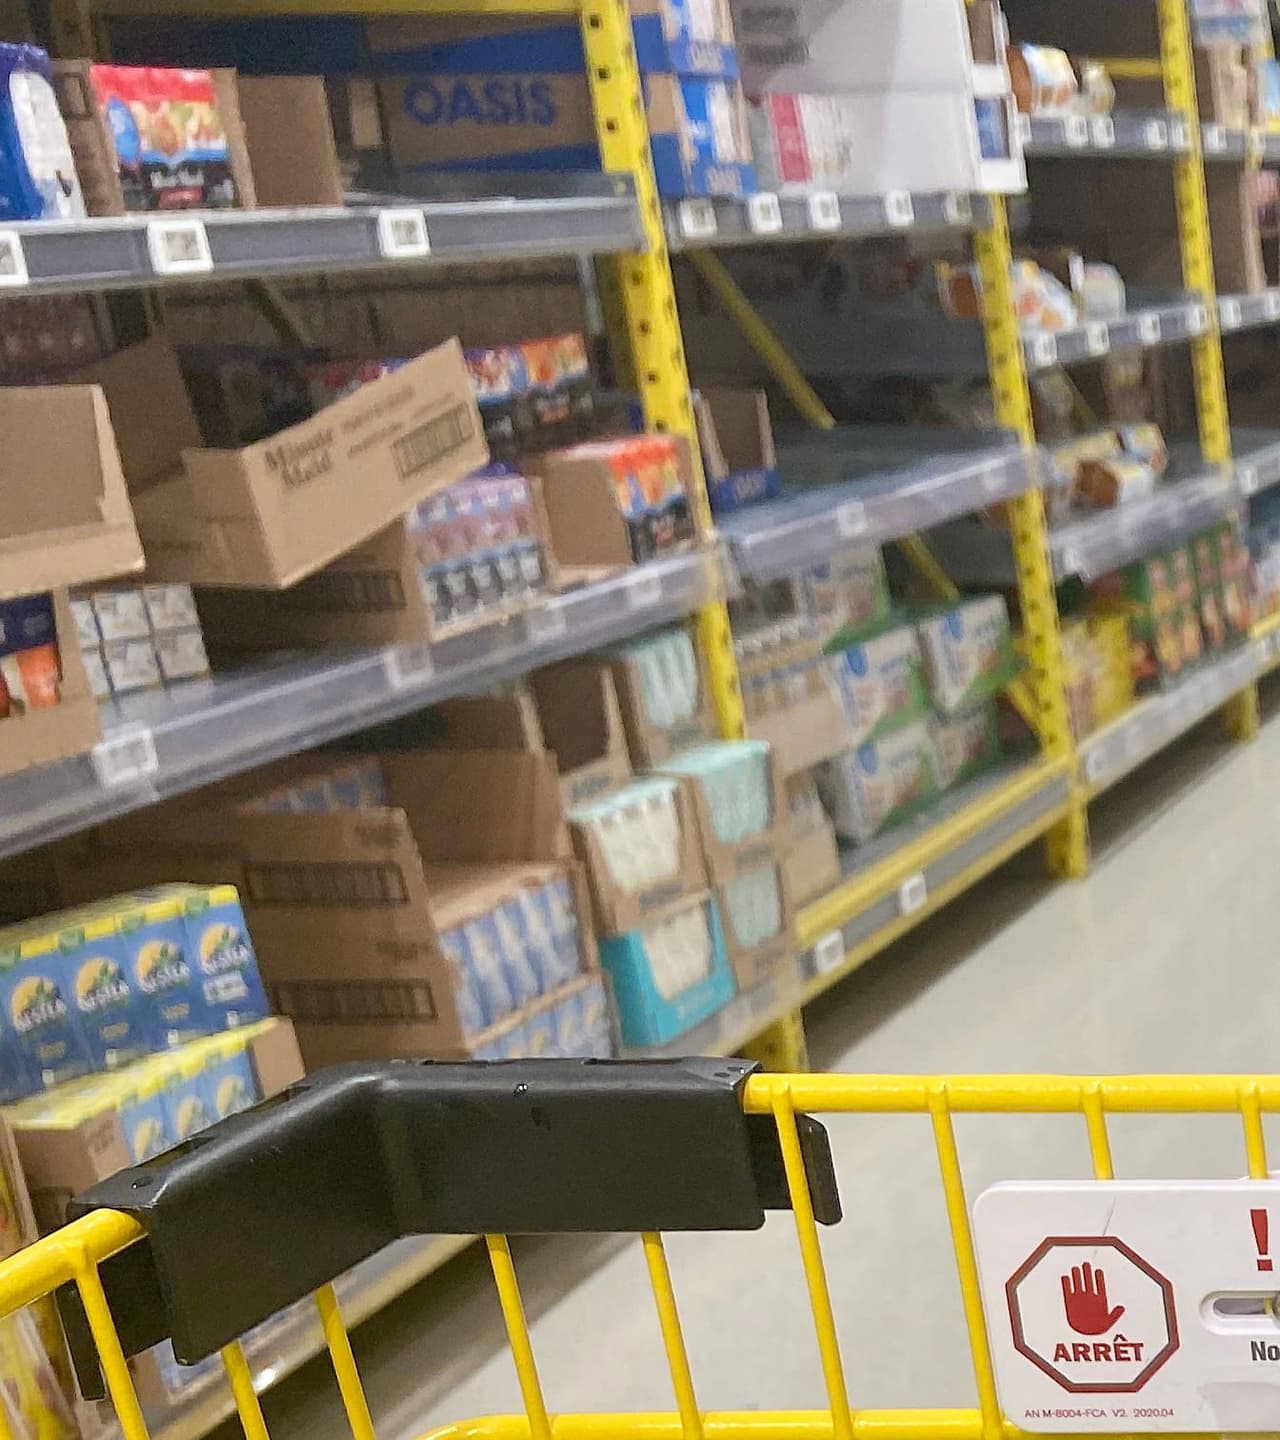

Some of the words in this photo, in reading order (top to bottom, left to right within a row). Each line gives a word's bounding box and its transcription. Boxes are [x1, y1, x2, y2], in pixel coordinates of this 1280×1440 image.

[403, 75, 558, 130] OASIS
[1053, 1333, 1145, 1362] ARRÊT
[1024, 1408, 1040, 1419] AN
